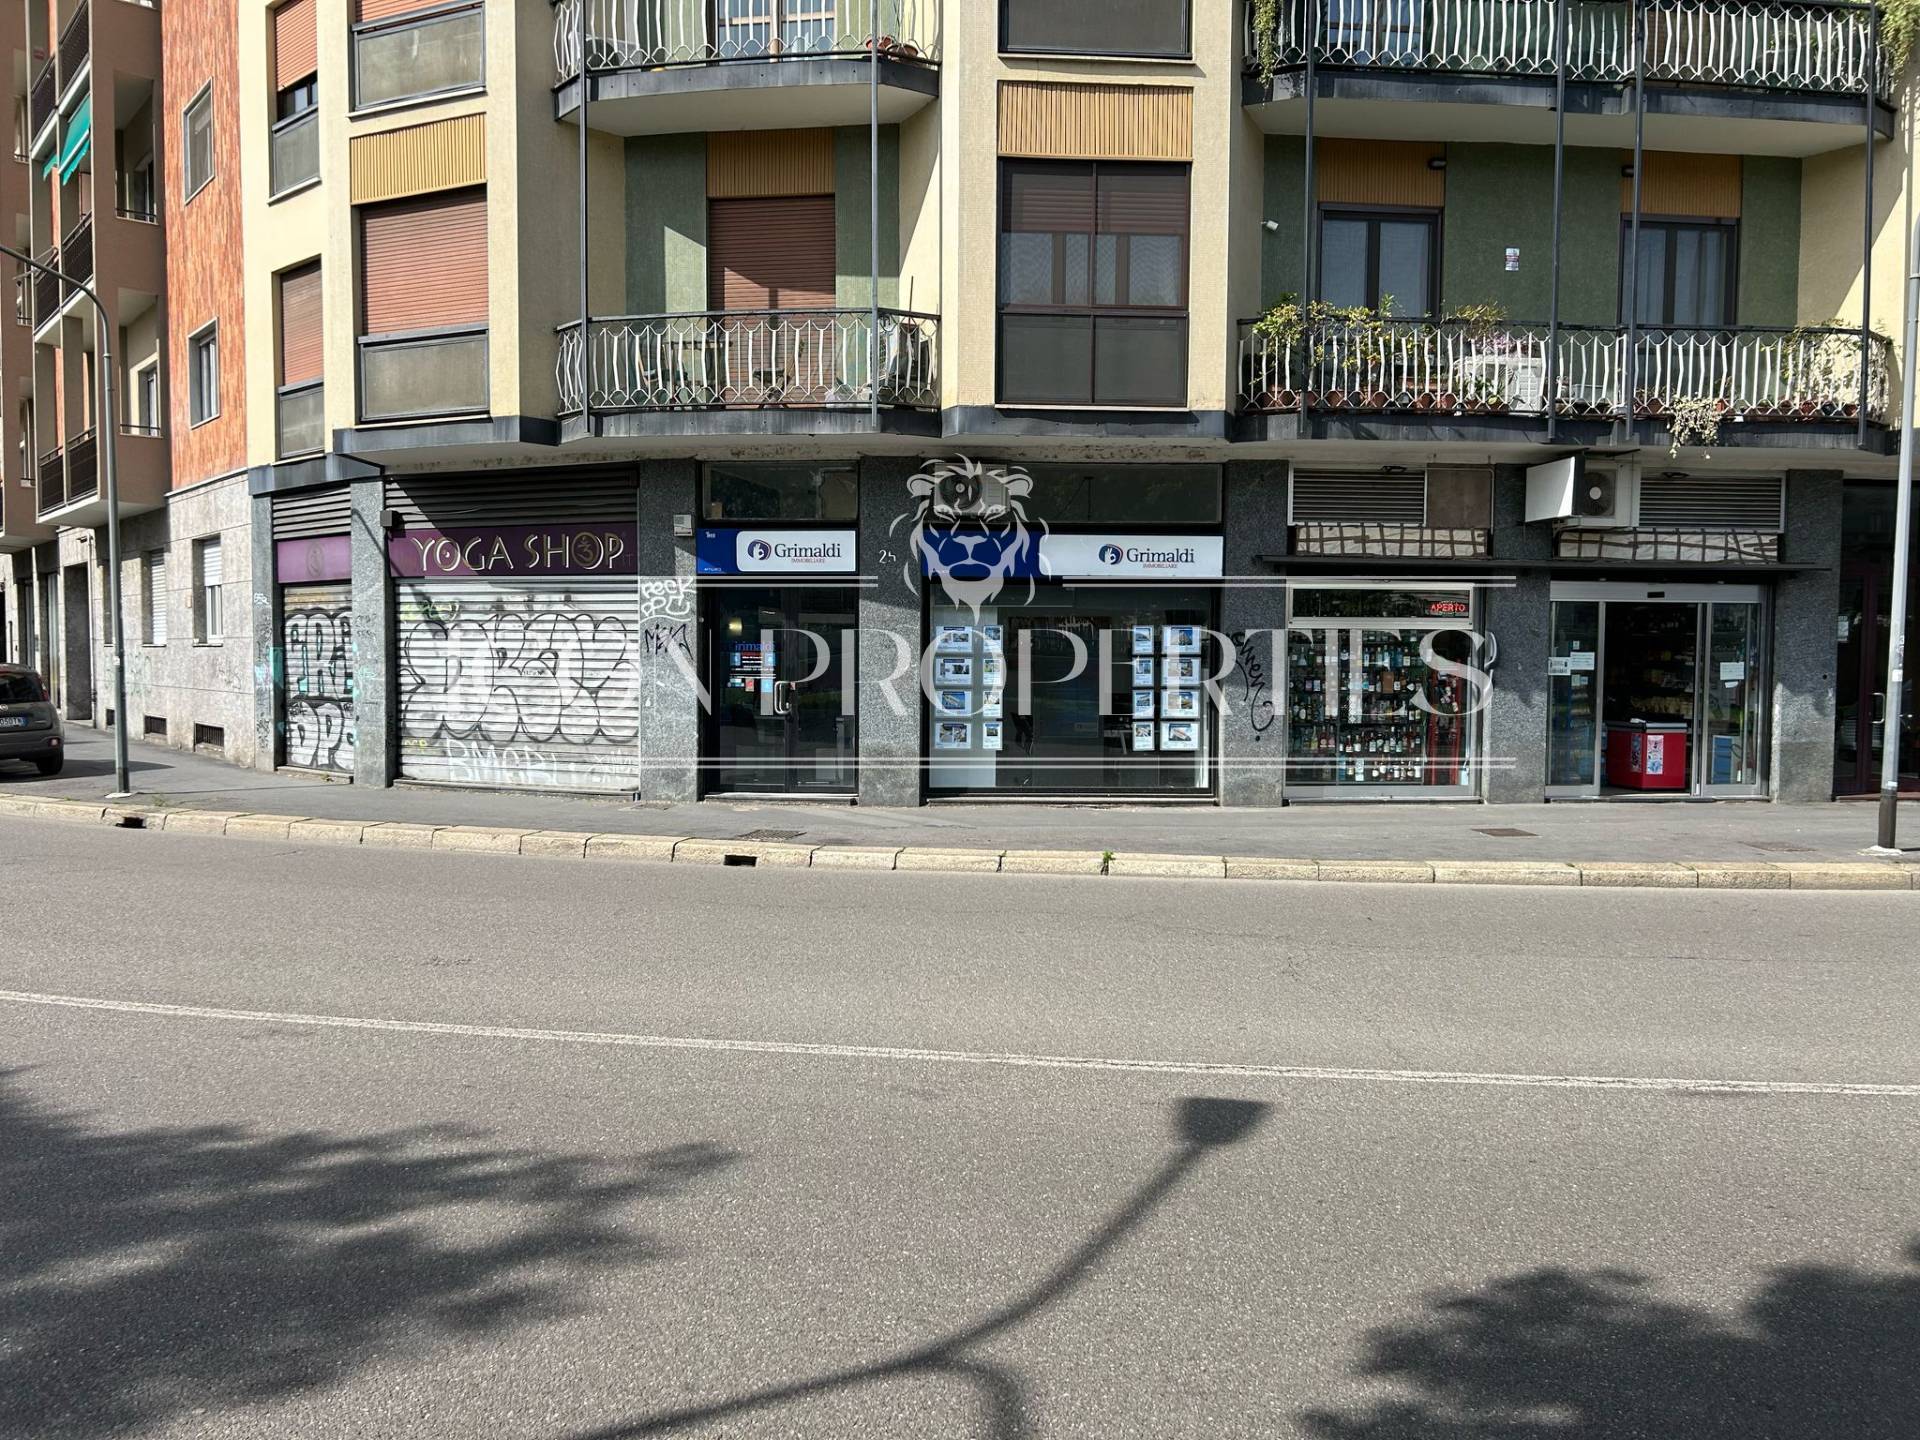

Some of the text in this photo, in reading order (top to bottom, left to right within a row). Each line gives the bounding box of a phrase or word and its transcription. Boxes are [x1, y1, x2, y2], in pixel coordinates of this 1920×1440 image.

[411, 535, 515, 572] YOGA
[522, 530, 625, 571] SHOP
[774, 543, 842, 558] Grimaldi
[1126, 547, 1195, 564] Grimaldi
[1431, 603, 1466, 613] APERTO
